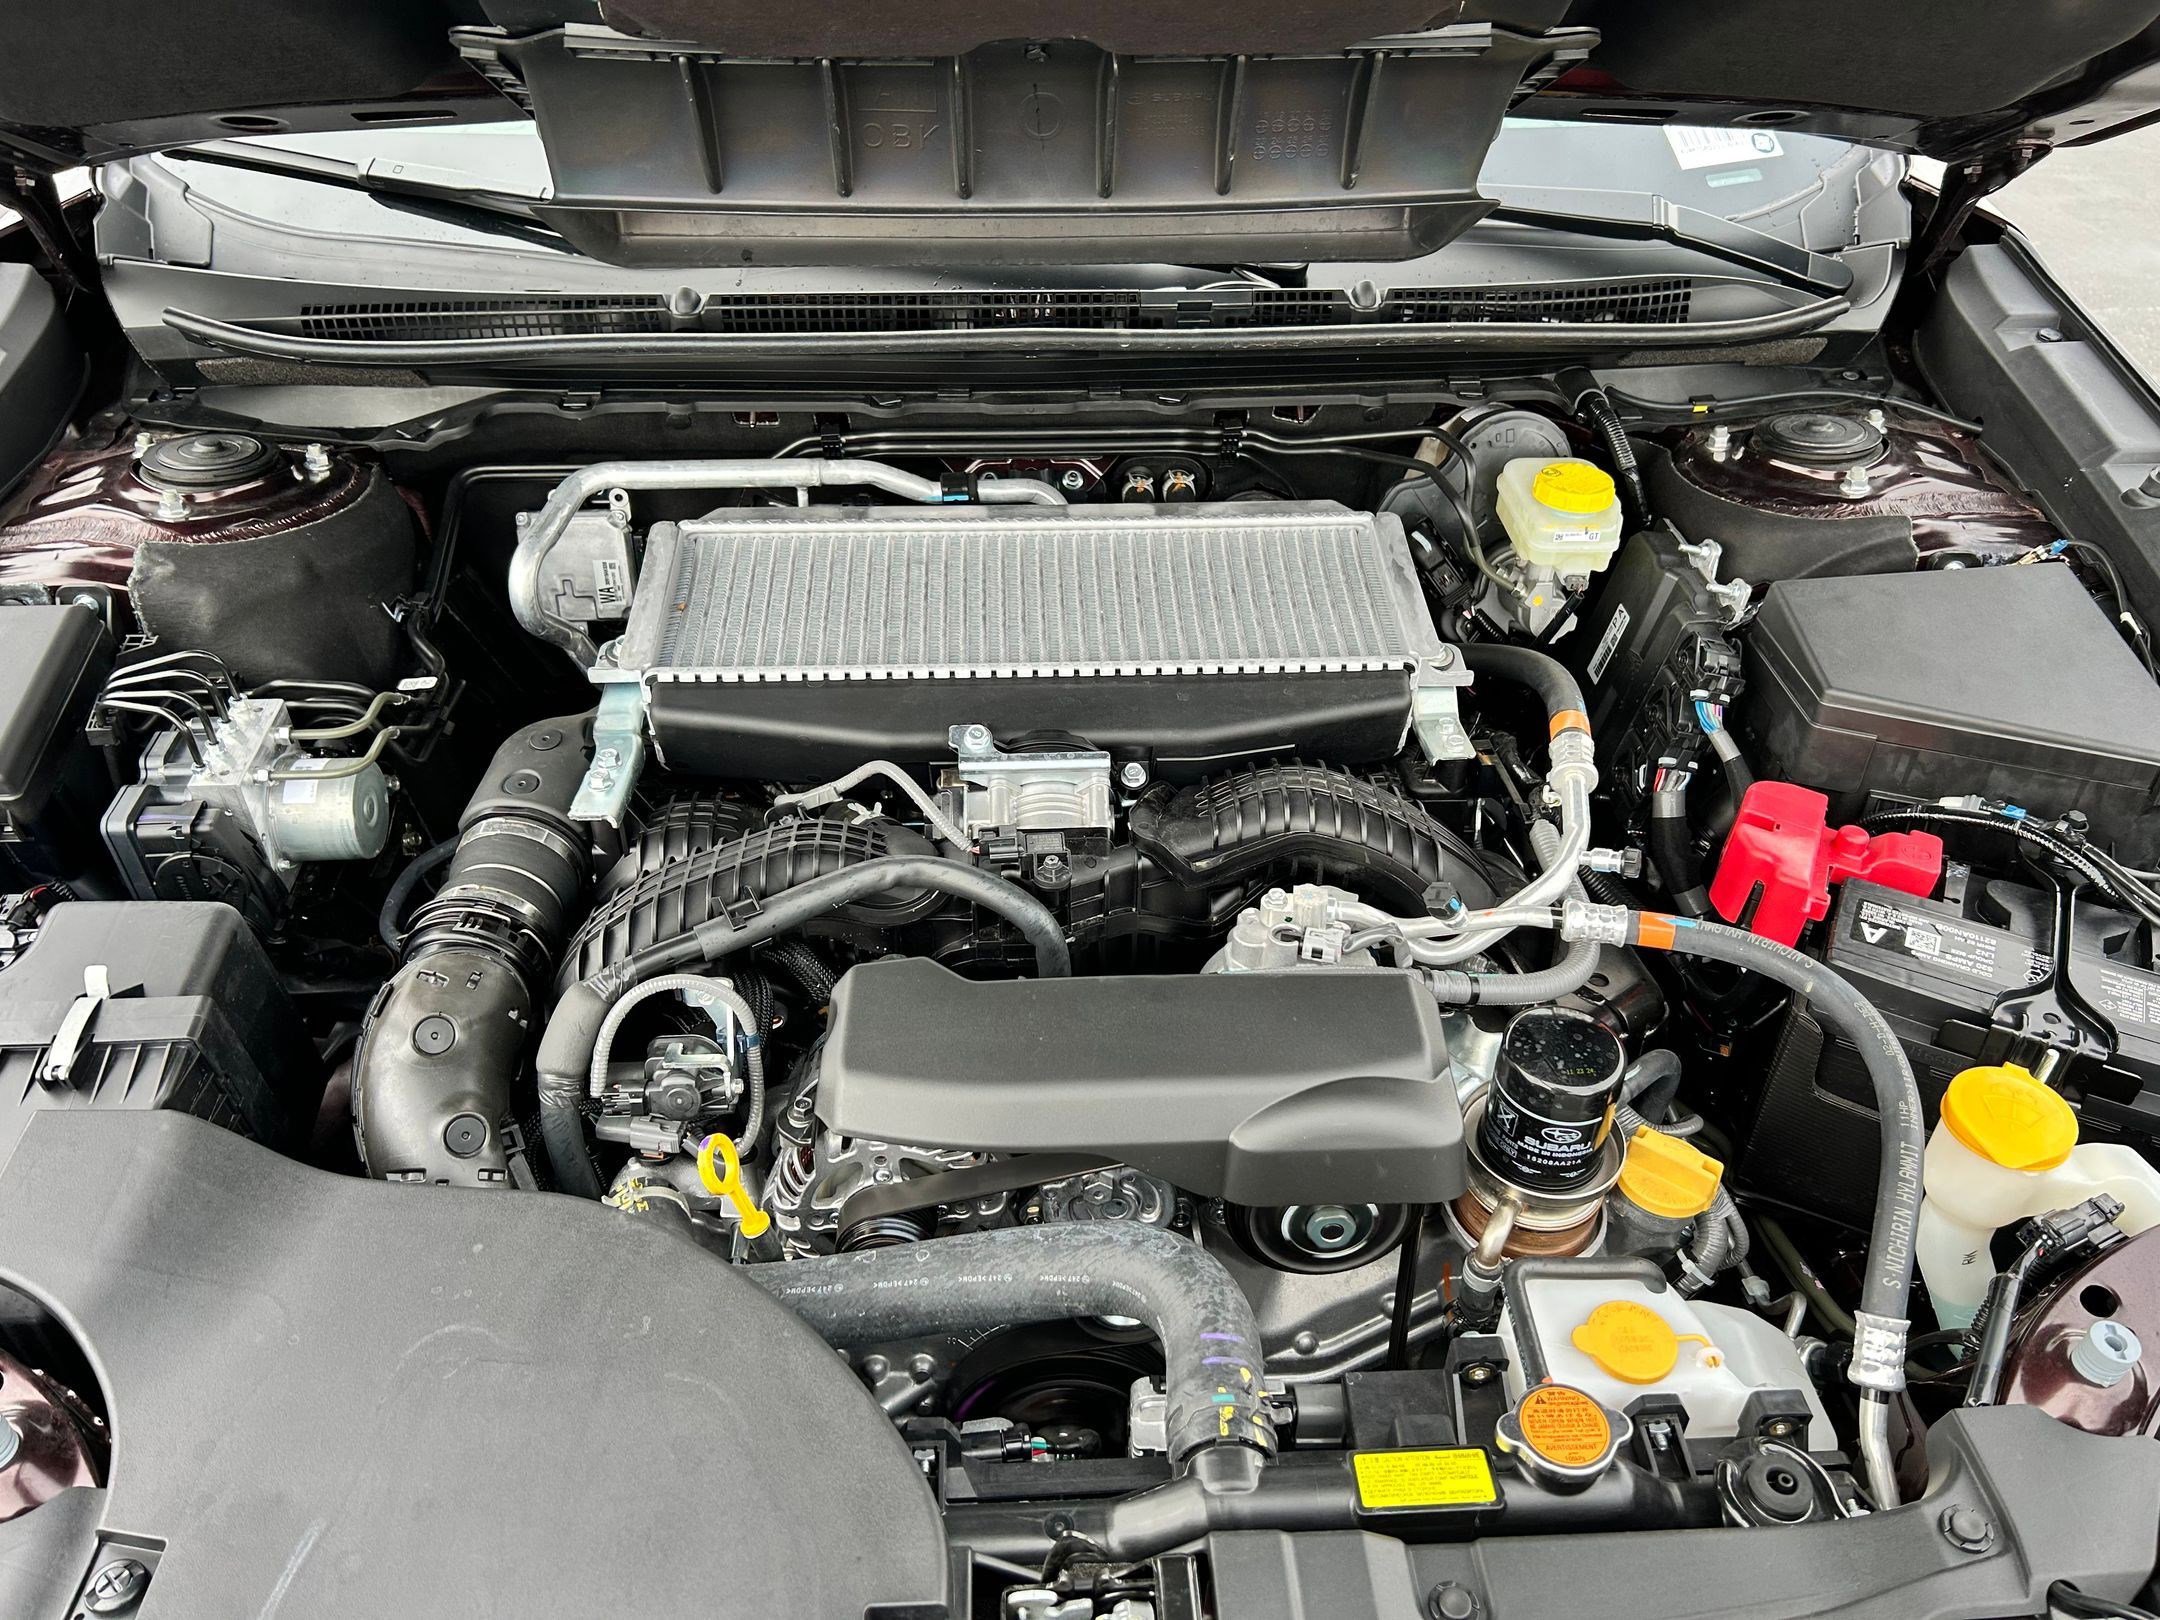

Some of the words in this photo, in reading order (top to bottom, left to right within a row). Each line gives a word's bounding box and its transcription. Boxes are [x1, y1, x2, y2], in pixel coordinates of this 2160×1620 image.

[1588, 532, 1599, 540] GT
[598, 586, 616, 604] WA
[1860, 922, 1888, 944] A
[1946, 954, 1974, 966] AMPS
[1976, 949, 1994, 958] LN2
[1972, 968, 1992, 978] COLD
[1518, 1141, 1540, 1154] MADE
[1552, 1148, 1593, 1158] INDONESIA
[1524, 1136, 1591, 1152] SUBARU
[1896, 1141, 1919, 1204] HYLAMMIT
